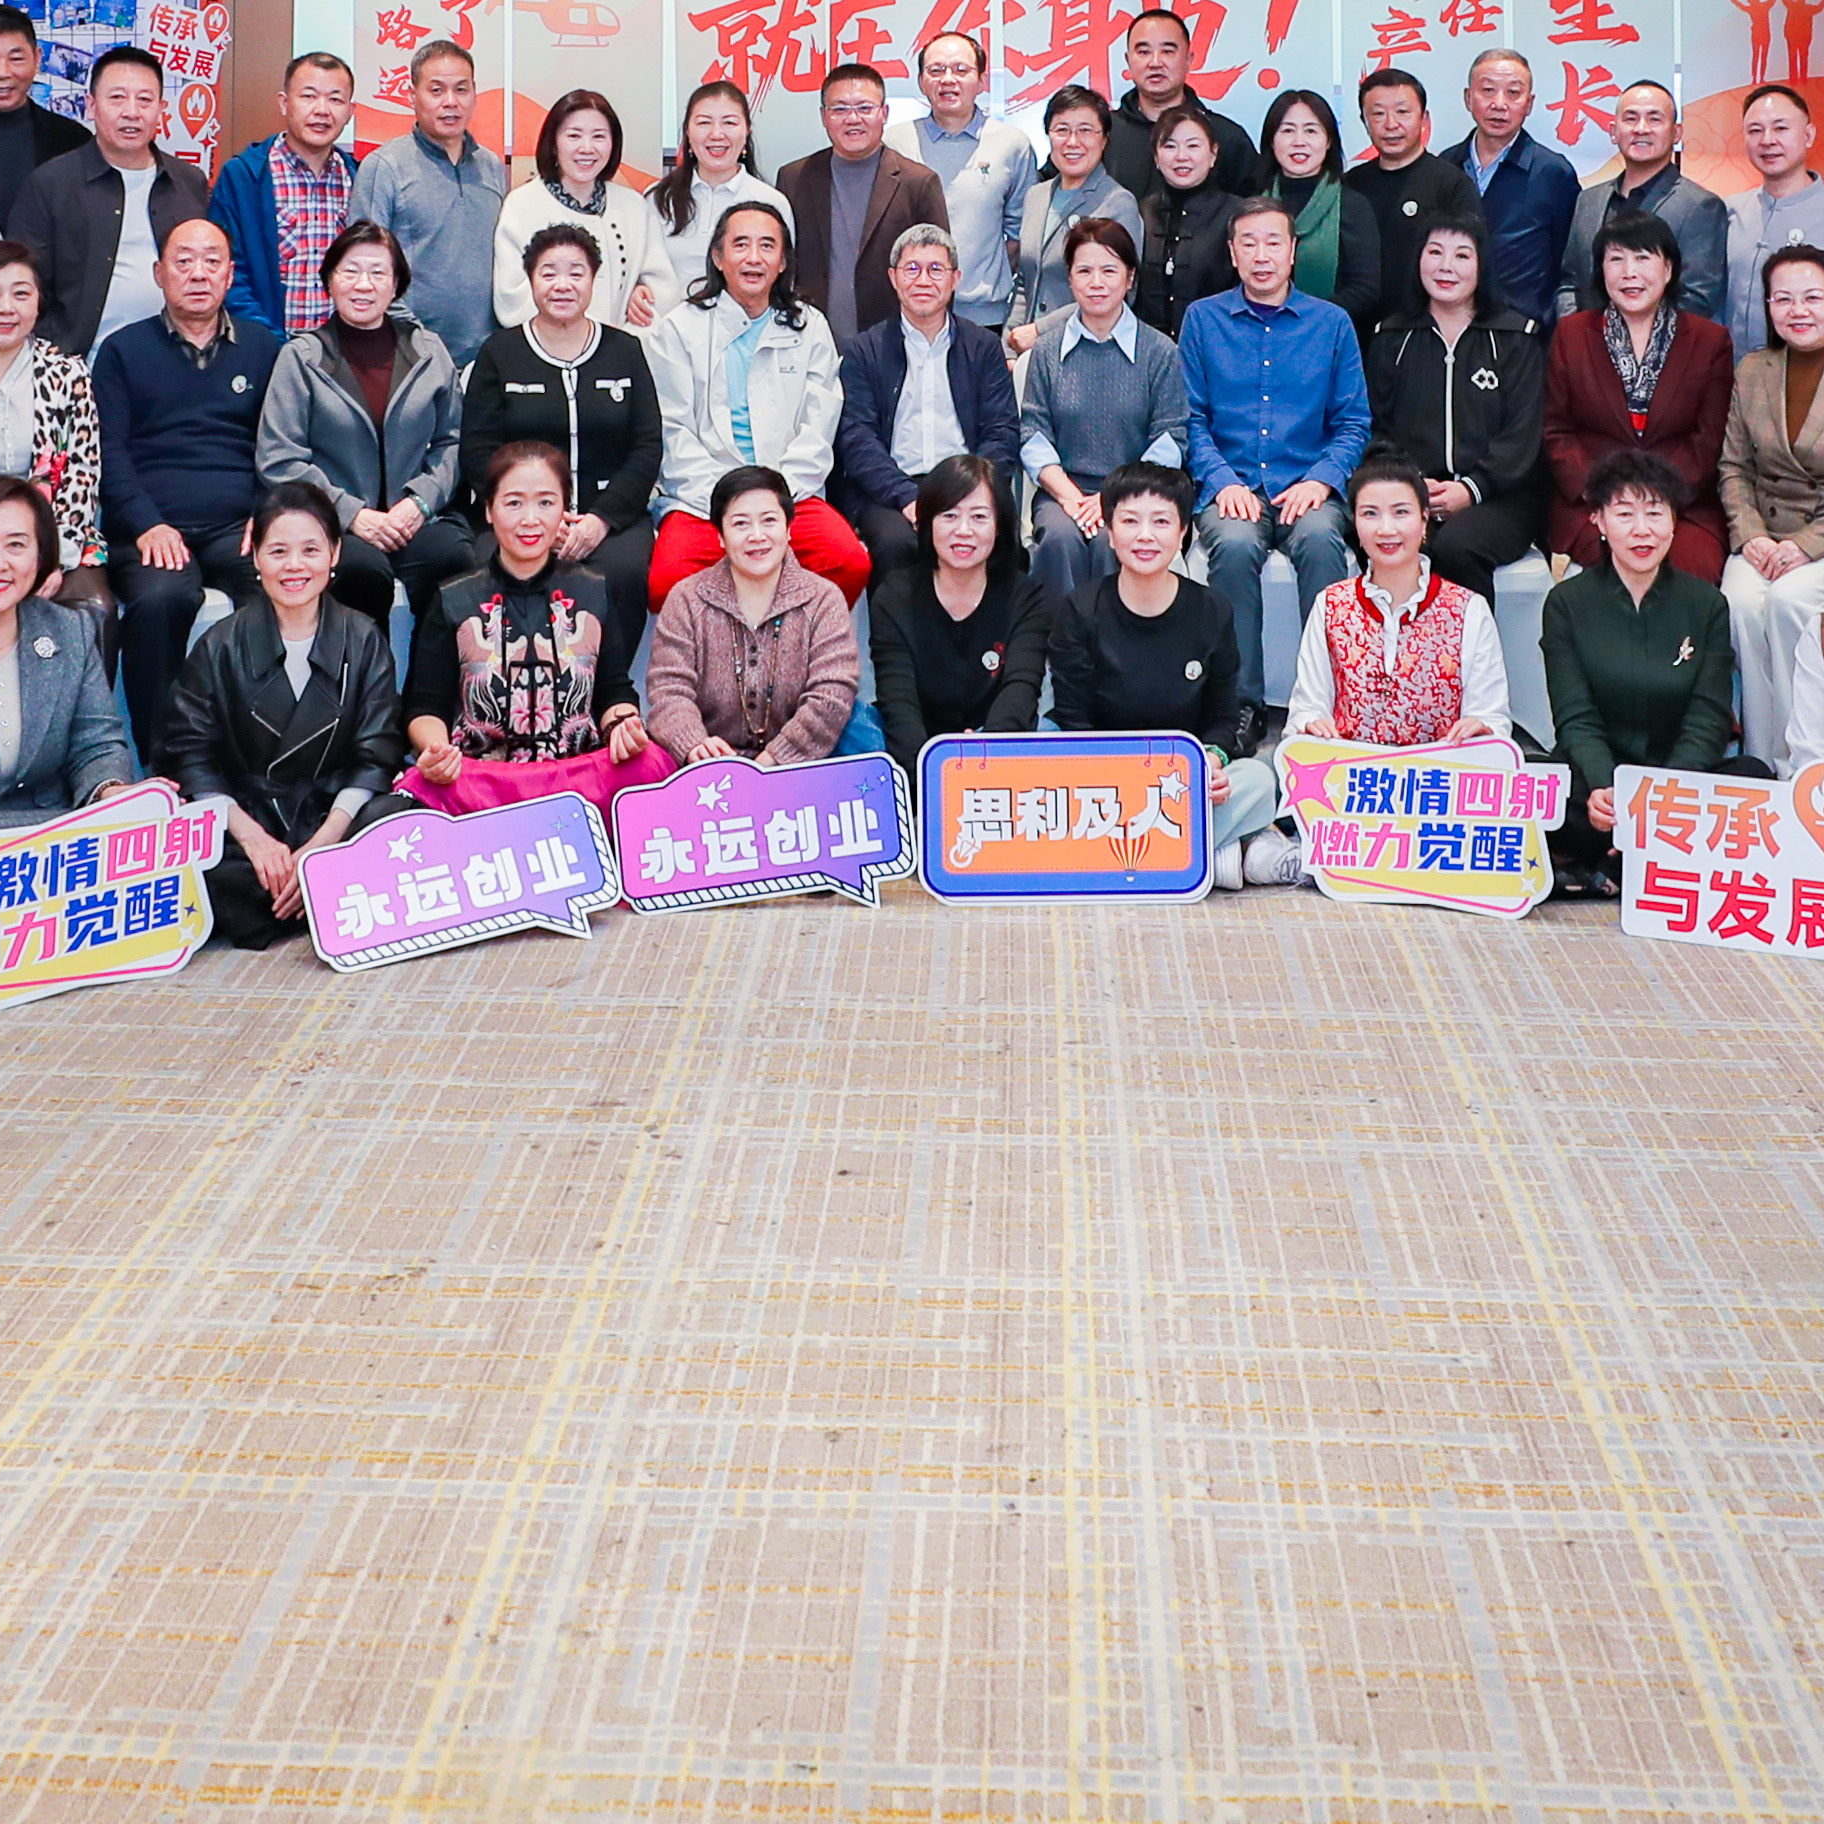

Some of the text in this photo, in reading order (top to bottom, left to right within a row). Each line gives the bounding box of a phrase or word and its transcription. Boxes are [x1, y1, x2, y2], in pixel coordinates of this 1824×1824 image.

[149, 4, 198, 40] 传承
[148, 38, 216, 79] 与发展
[961, 785, 1182, 843] 思利及人
[1344, 767, 1563, 822] 激情四射
[1626, 775, 1782, 860] 传承
[639, 799, 883, 884] 永远创业
[1308, 817, 1525, 874] 燃力觉醒
[335, 834, 586, 940] 永远创业
